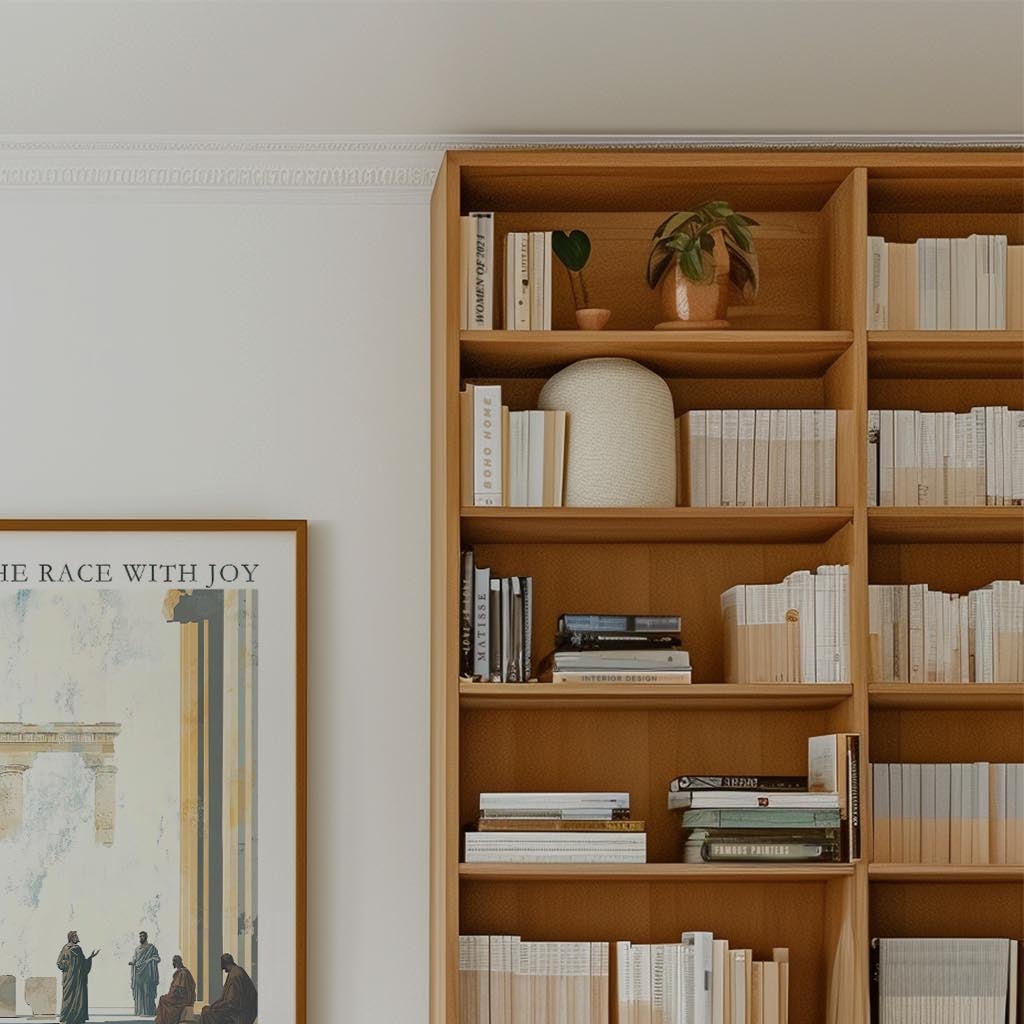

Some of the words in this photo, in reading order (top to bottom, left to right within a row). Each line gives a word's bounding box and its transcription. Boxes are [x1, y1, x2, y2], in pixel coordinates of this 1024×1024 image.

[476, 234, 485, 258] 2024
[475, 259, 485, 276] OF
[475, 278, 485, 323] WOMEN
[483, 397, 492, 439] HOME
[483, 447, 492, 489] BOHO
[38, 563, 113, 583] RACE
[122, 563, 198, 583] WITH
[204, 563, 260, 588] JOY
[477, 592, 487, 661] MATISSE
[714, 846, 748, 855] FAMOUS
[750, 846, 790, 855] PAINTERS
